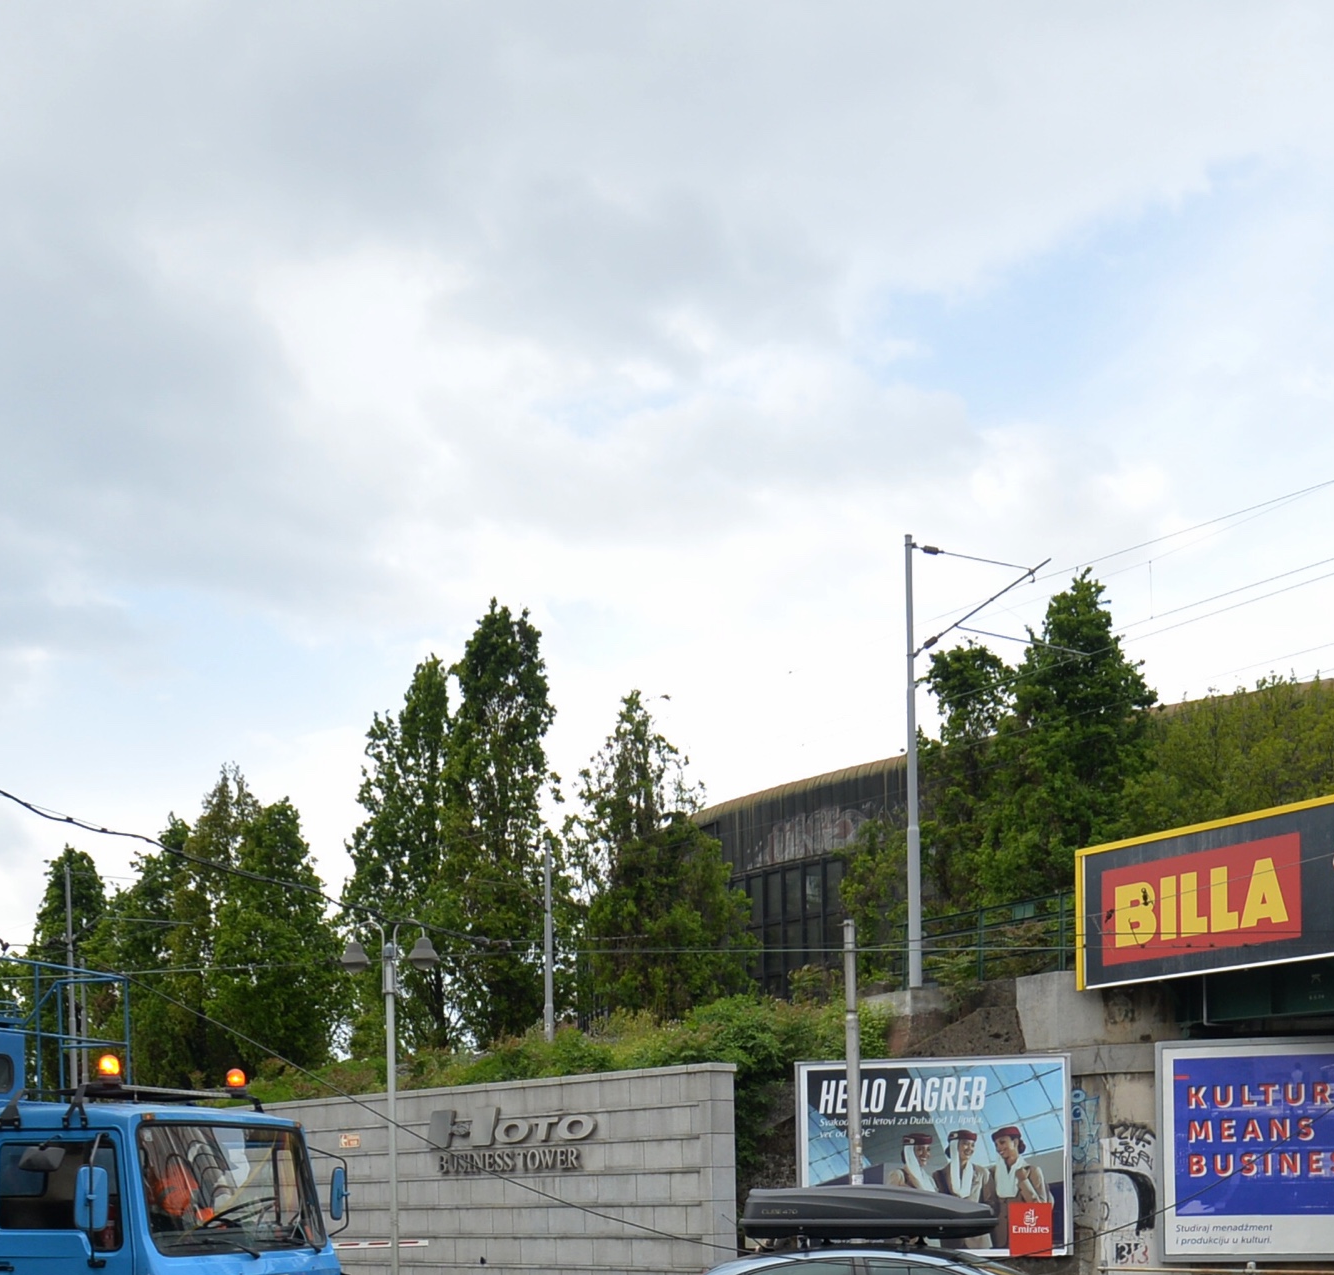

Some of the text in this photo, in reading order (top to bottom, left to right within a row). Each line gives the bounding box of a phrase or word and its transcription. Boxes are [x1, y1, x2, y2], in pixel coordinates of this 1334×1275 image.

[1115, 857, 1289, 948] BILLA
[819, 1075, 987, 1114] HELO ZAGREB
[872, 1115, 896, 1126] letovi
[897, 1117, 908, 1125] za
[909, 1115, 933, 1125] Dubai
[935, 1115, 947, 1125] od
[835, 1128, 847, 1138] od
[1188, 1116, 1315, 1143] MEANS
[437, 1147, 579, 1174] BUSINESS TOWER
[1012, 1225, 1050, 1234] Emirates
[1176, 1223, 1273, 1235] Studiraj menadžment
[1181, 1236, 1230, 1246] produkciju
